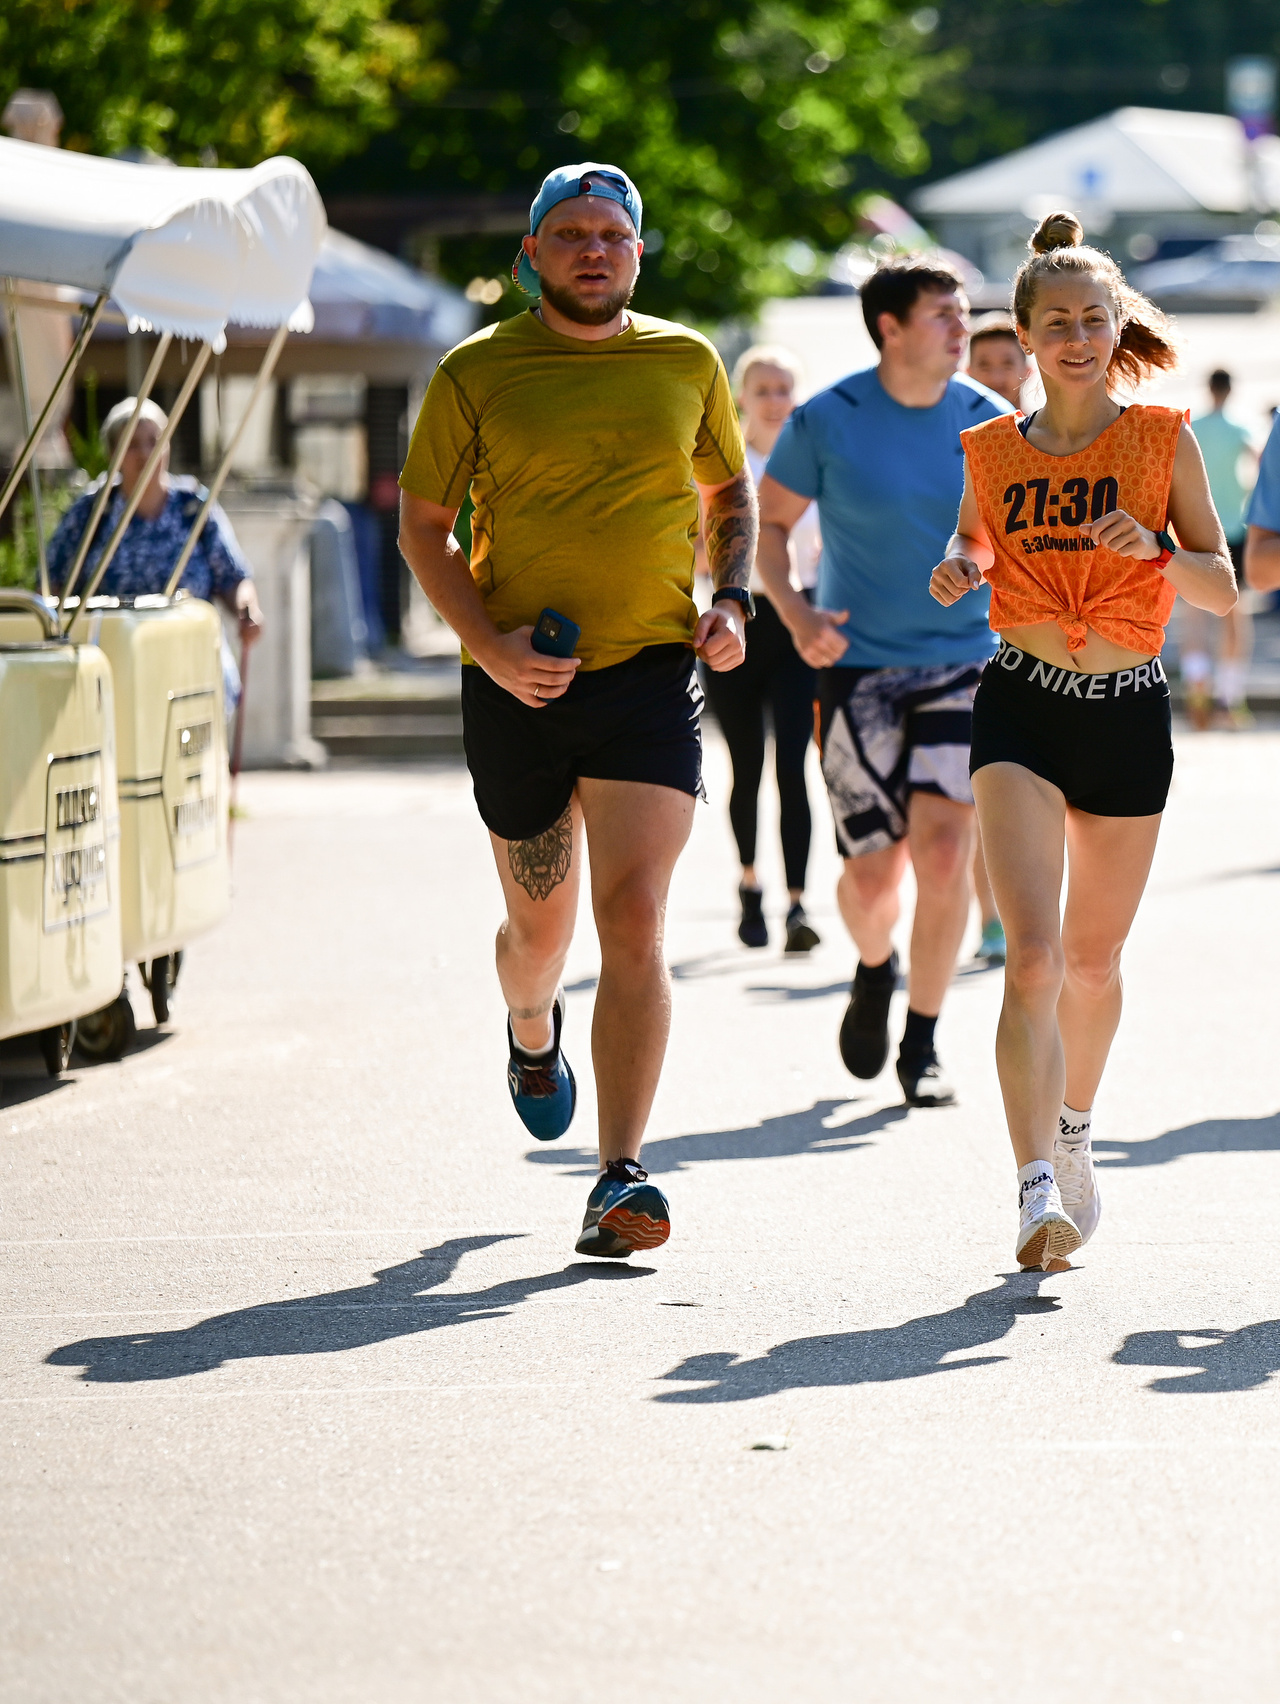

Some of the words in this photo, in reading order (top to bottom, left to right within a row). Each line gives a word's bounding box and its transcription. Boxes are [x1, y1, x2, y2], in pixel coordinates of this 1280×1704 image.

[1003, 476, 1119, 535] 27:30
[1027, 660, 1110, 699] NIKE
[1114, 655, 1166, 697] PRO
